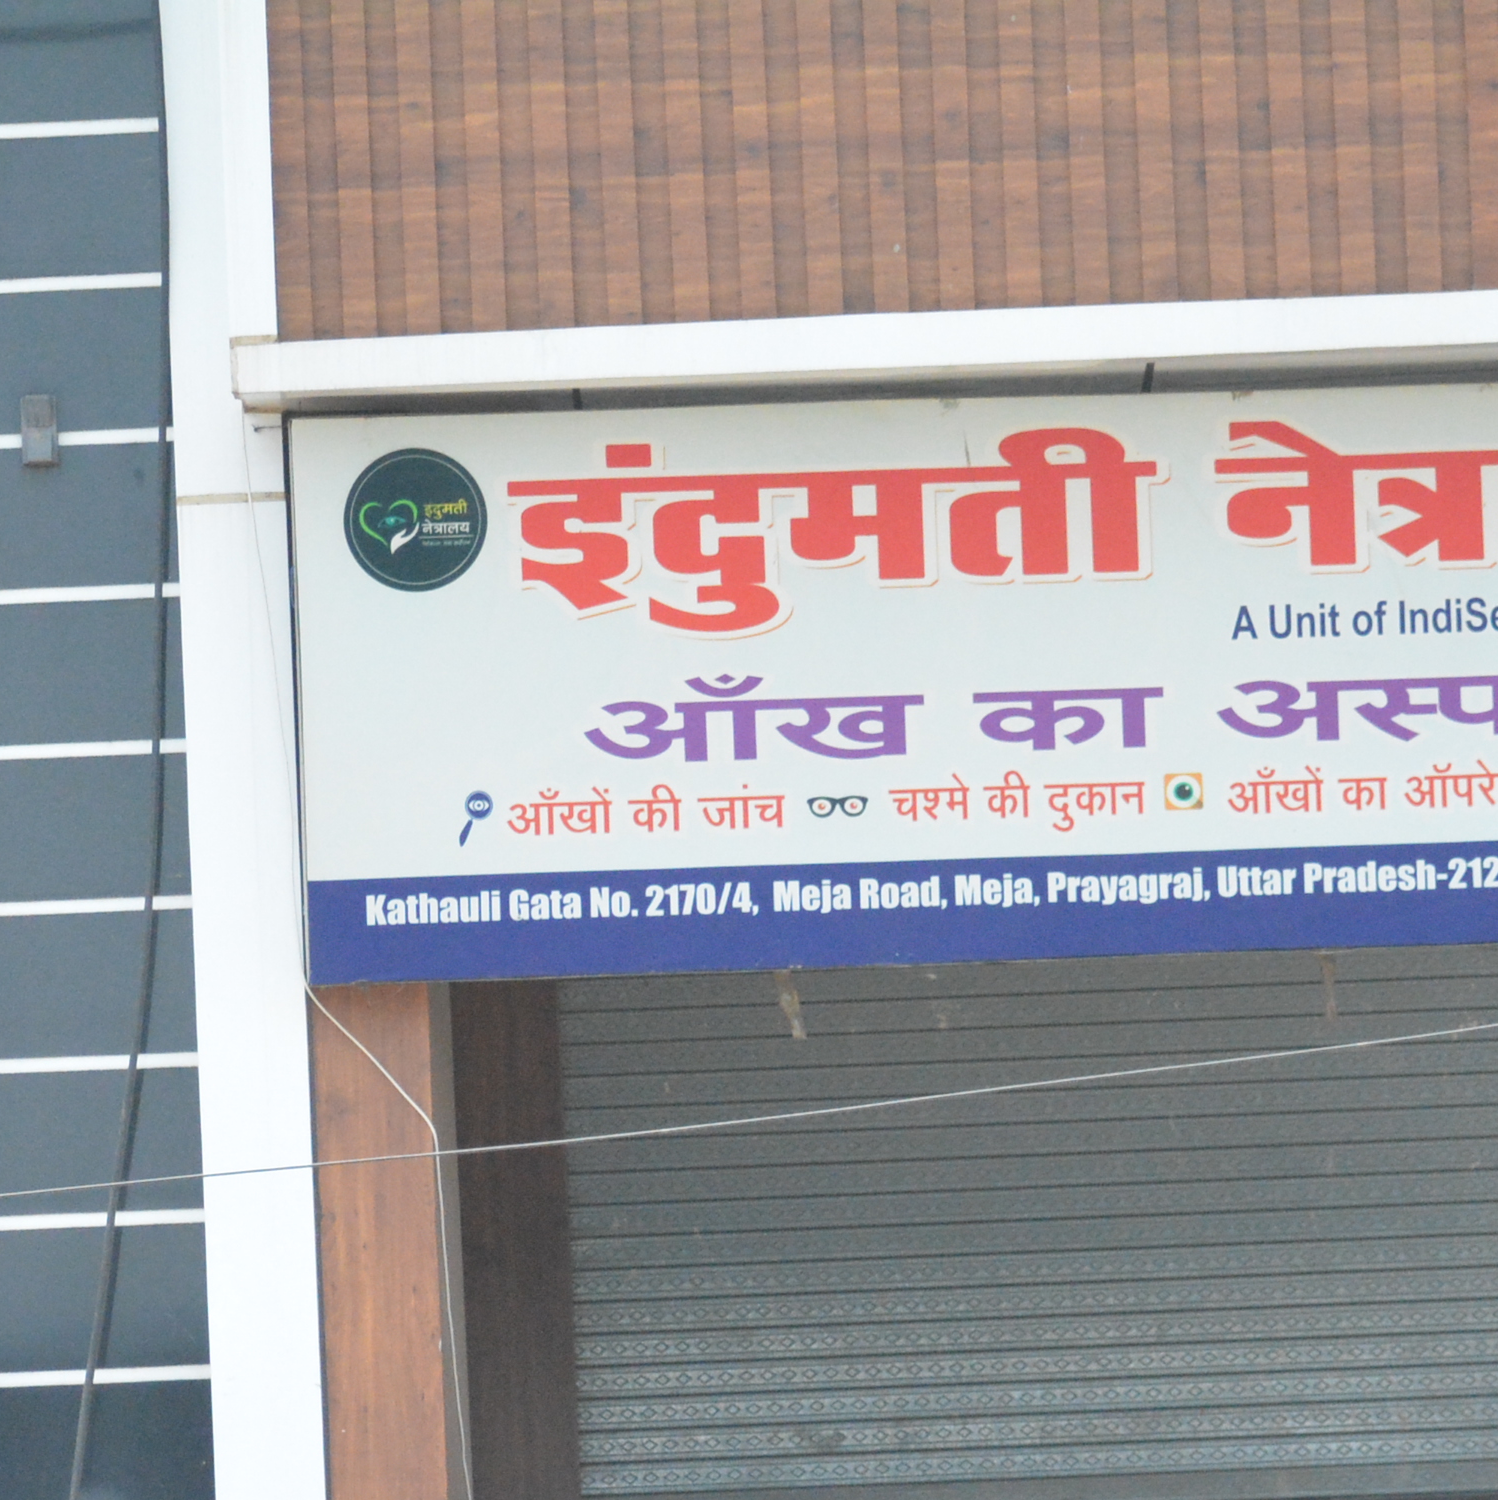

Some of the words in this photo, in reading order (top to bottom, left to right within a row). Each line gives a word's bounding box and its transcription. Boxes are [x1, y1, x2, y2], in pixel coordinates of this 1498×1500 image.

[506, 426, 1158, 632] इंदुमती
[1231, 605, 1257, 640] A
[1269, 602, 1341, 639] Unit
[1353, 600, 1388, 636] of
[584, 674, 924, 762] आँख
[973, 687, 1163, 750] का
[507, 787, 612, 836] आँखों
[628, 784, 682, 832] की
[697, 784, 785, 829] जांच
[889, 773, 970, 821] चश्मे
[983, 770, 1031, 818] की
[1044, 780, 1146, 832] दुकान
[1227, 765, 1324, 814] आँखों
[1339, 775, 1388, 810] का
[365, 889, 502, 926] Kathauli
[508, 888, 583, 922] Gata
[589, 886, 639, 918] No.
[644, 881, 759, 917] 2170/4,
[772, 879, 852, 914] Meja
[859, 875, 948, 910] Road,
[954, 872, 1041, 908] Meja,
[1047, 866, 1211, 906] Prayagraj,
[1216, 865, 1297, 898] Uttar
